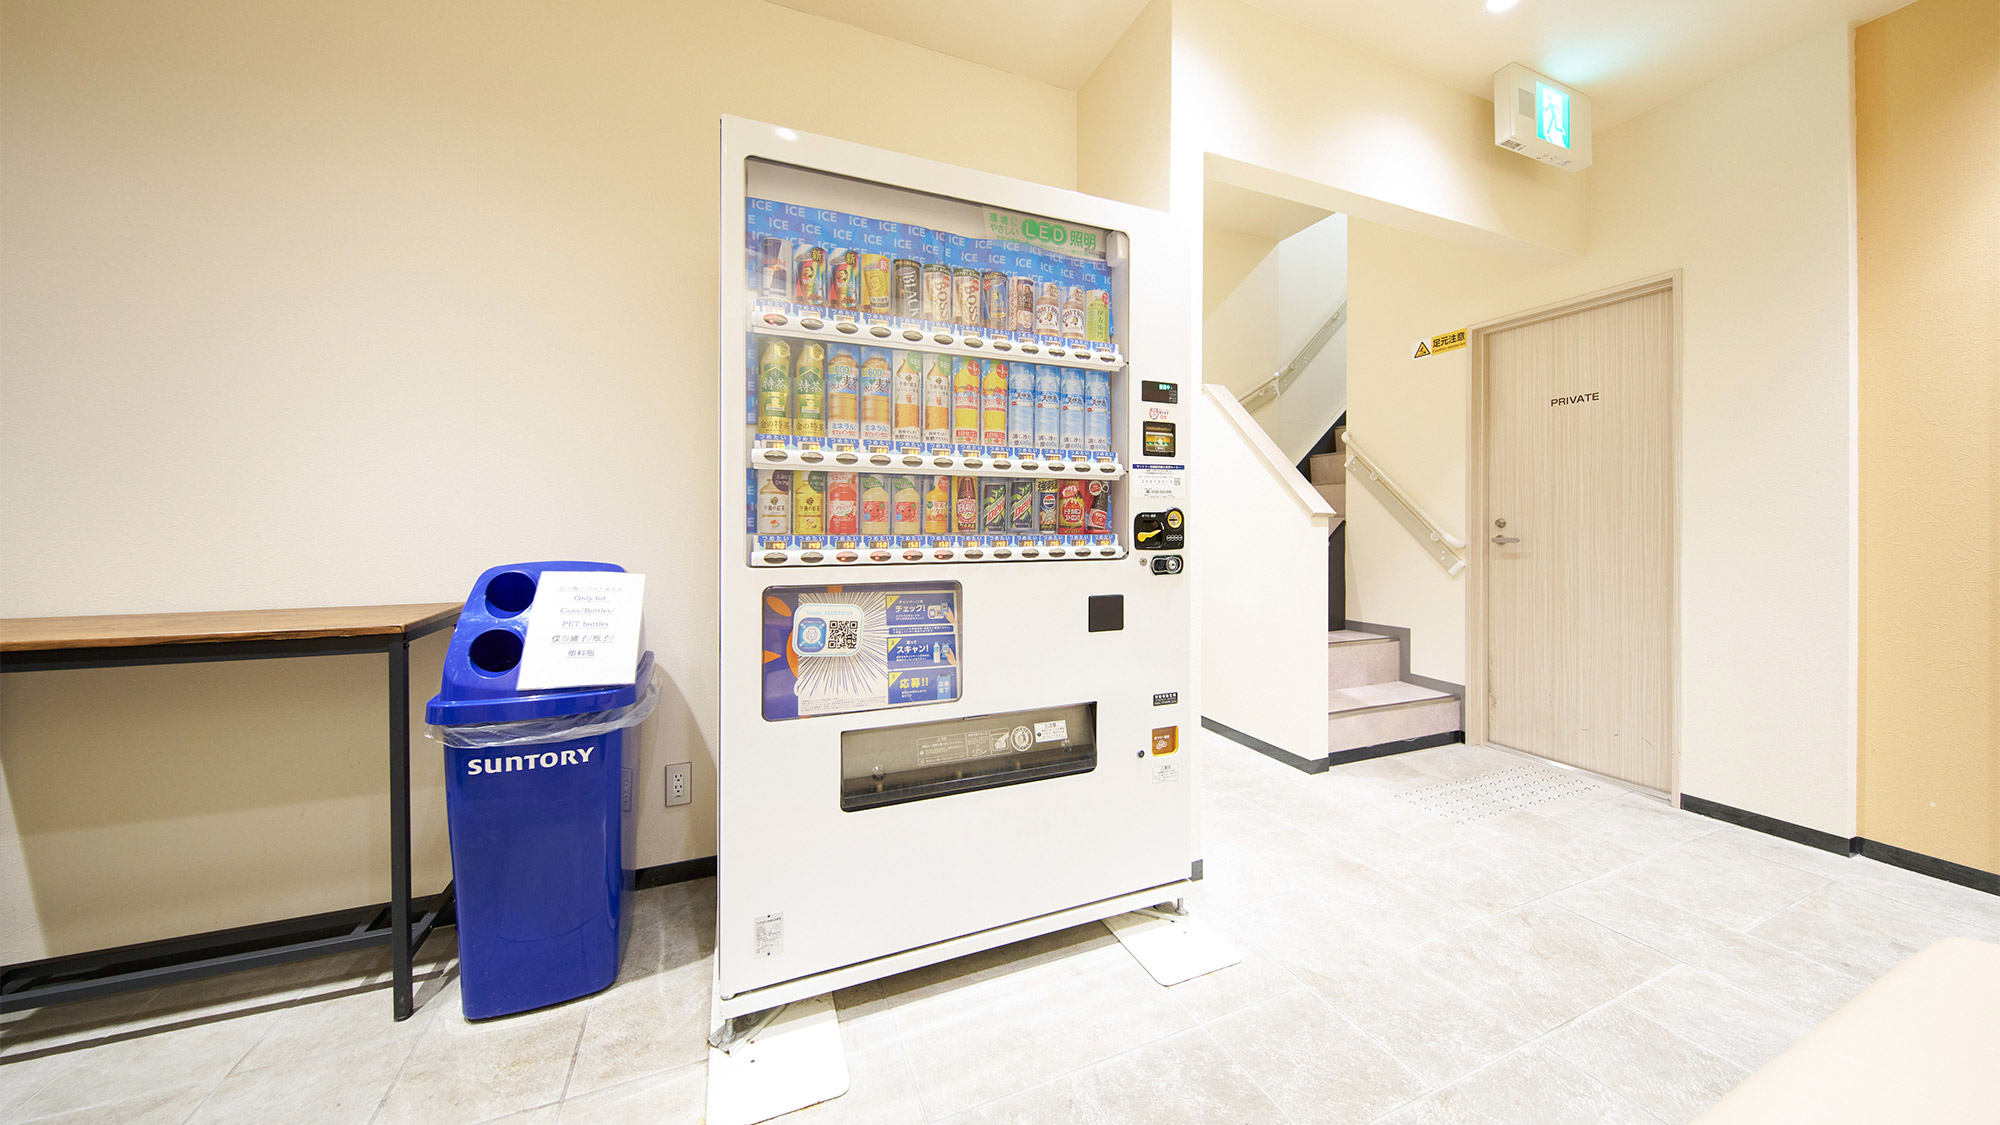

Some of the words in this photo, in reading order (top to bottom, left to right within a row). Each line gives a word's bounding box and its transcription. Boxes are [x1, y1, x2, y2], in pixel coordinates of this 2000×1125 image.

[990, 212, 1018, 226] 環境に
[751, 199, 773, 212] ICE
[785, 205, 806, 218] ICE
[817, 210, 838, 223] ICE
[849, 216, 868, 229] ICE
[879, 221, 897, 233] ICE
[908, 225, 926, 238] ICE
[948, 234, 966, 247] ICE
[975, 240, 993, 250] ICE
[1003, 241, 1020, 252] ICE
[1050, 252, 1064, 264] ICE
[1070, 257, 1085, 268] ICE
[1092, 261, 1107, 271] ICE
[990, 223, 1019, 236] やさしい
[1025, 221, 1064, 242] LED
[1070, 230, 1096, 250] 照明
[768, 217, 790, 230] ICE
[801, 223, 822, 236] ICE
[833, 228, 853, 241] ICE
[864, 233, 883, 246] ICE
[894, 238, 912, 250] ICE
[922, 243, 939, 255] ICE
[961, 251, 978, 263] ICE
[989, 254, 1006, 264] ICE
[1015, 257, 1032, 269] ICE
[1040, 262, 1054, 274] ICE
[1060, 268, 1074, 279] ICE
[1082, 272, 1096, 283] ICE
[879, 258, 889, 272] 新
[902, 269, 921, 317] BLACK
[936, 282, 950, 321] BOSS
[965, 285, 979, 324] BOSS
[1432, 331, 1466, 348] 足元注意
[834, 365, 850, 374] 600
[868, 368, 882, 377] 600
[762, 377, 788, 390] 特茶
[798, 380, 822, 393] 特茶
[1550, 391, 1600, 407] PRIVATE
[760, 420, 790, 430] 金の特茶
[796, 422, 824, 431] 金の特茶
[895, 604, 926, 613] チェック!
[896, 644, 929, 654] スキャン!
[899, 677, 929, 689] 応募!!
[467, 746, 595, 776] SUNTORY
